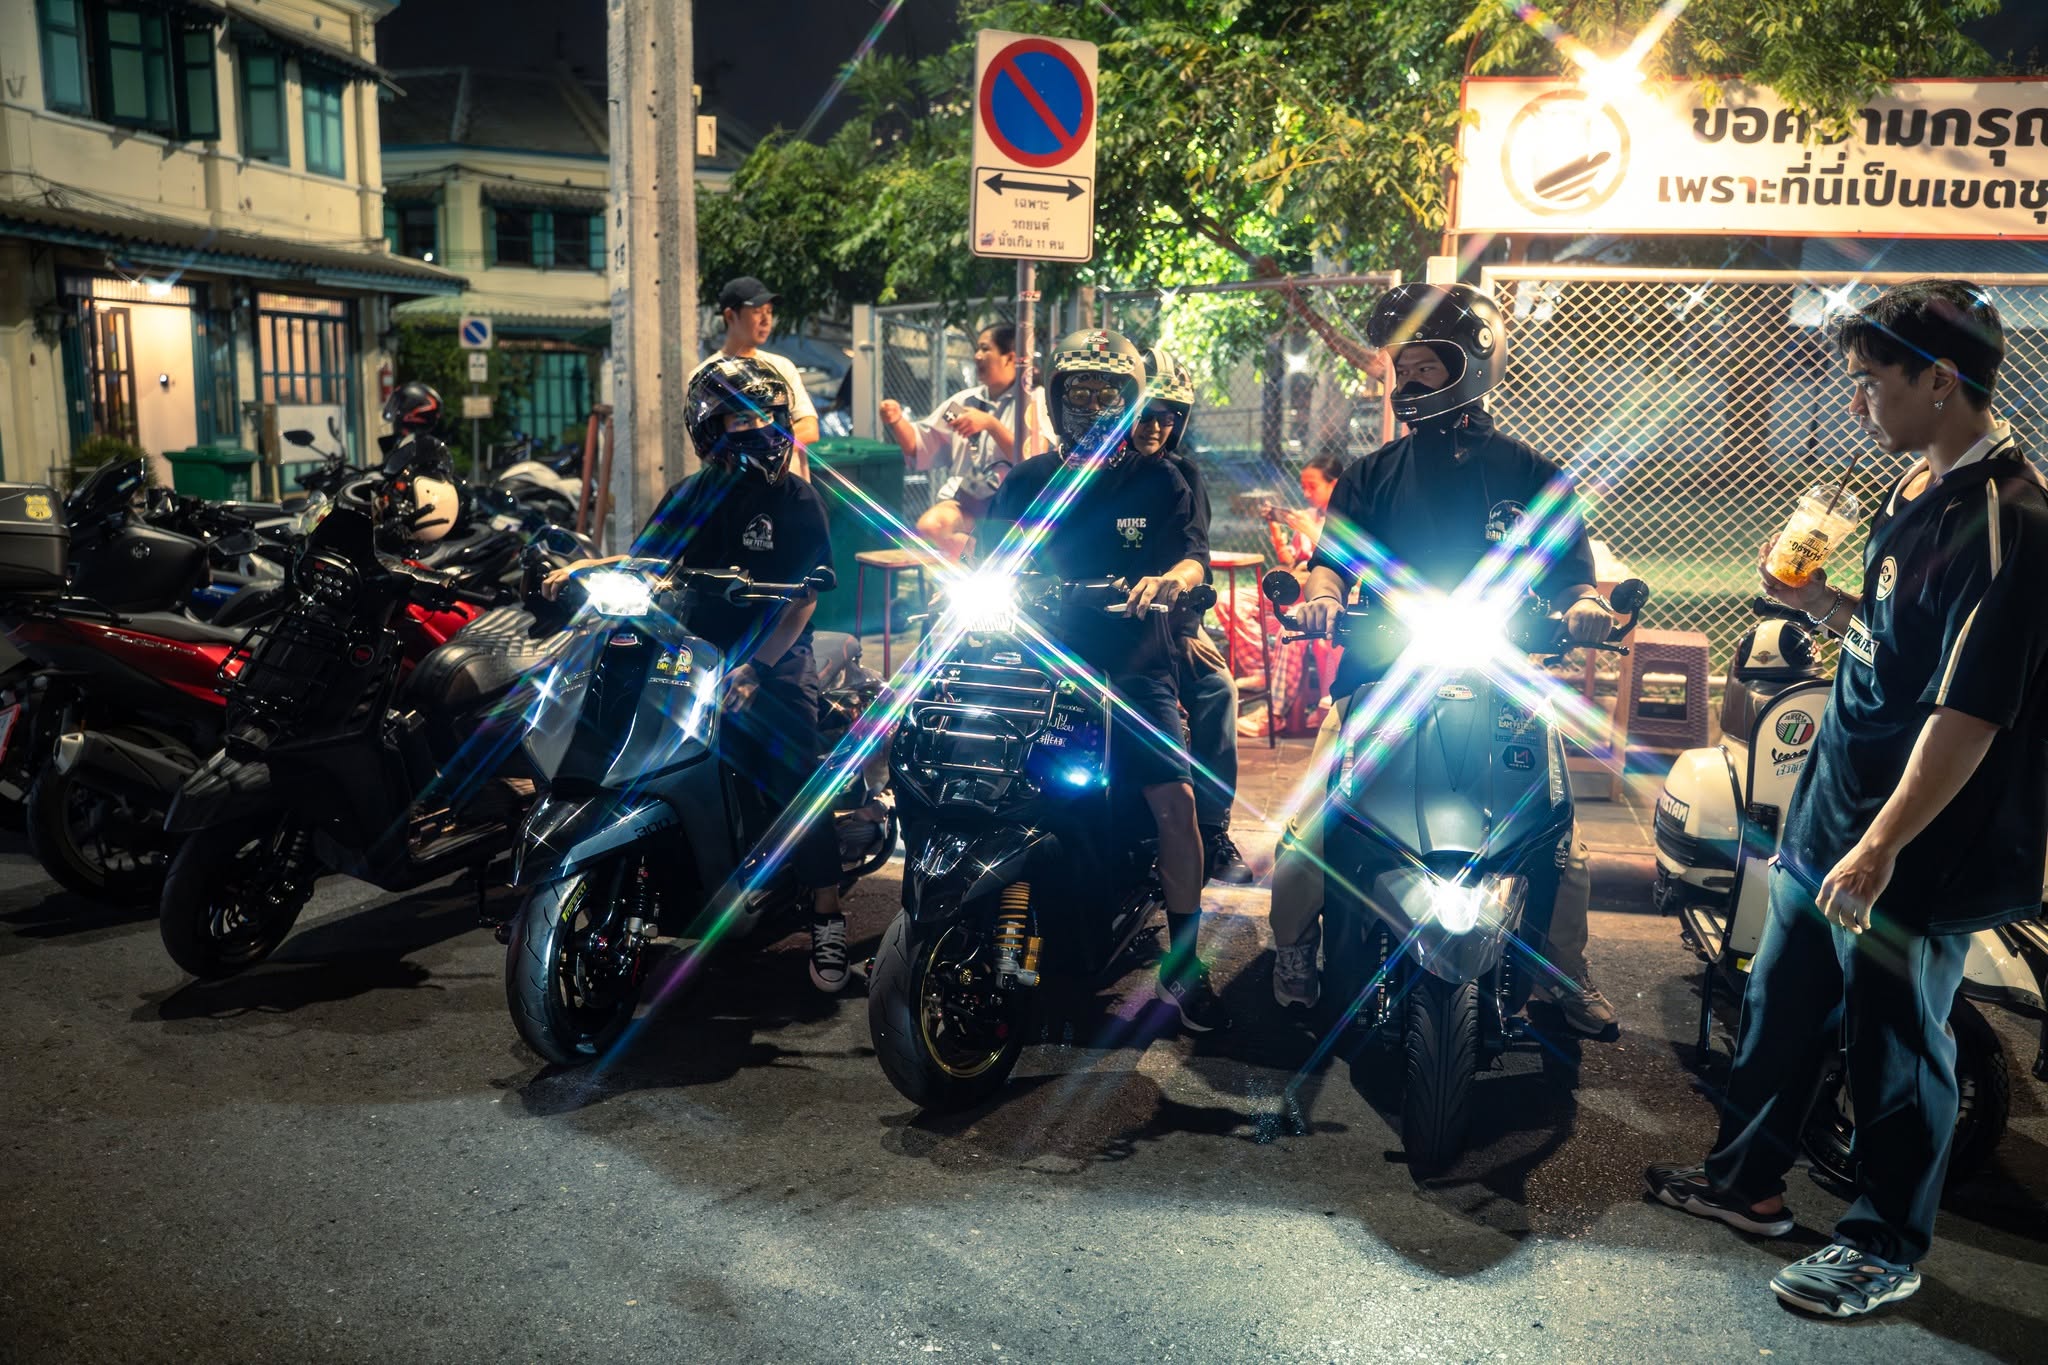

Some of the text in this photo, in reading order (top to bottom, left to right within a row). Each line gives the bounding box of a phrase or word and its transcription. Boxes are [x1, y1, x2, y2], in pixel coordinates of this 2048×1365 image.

[1014, 198, 1050, 210] เฉพาะ
[1011, 217, 1051, 231] รถยนต์
[1116, 518, 1147, 528] MIKE
